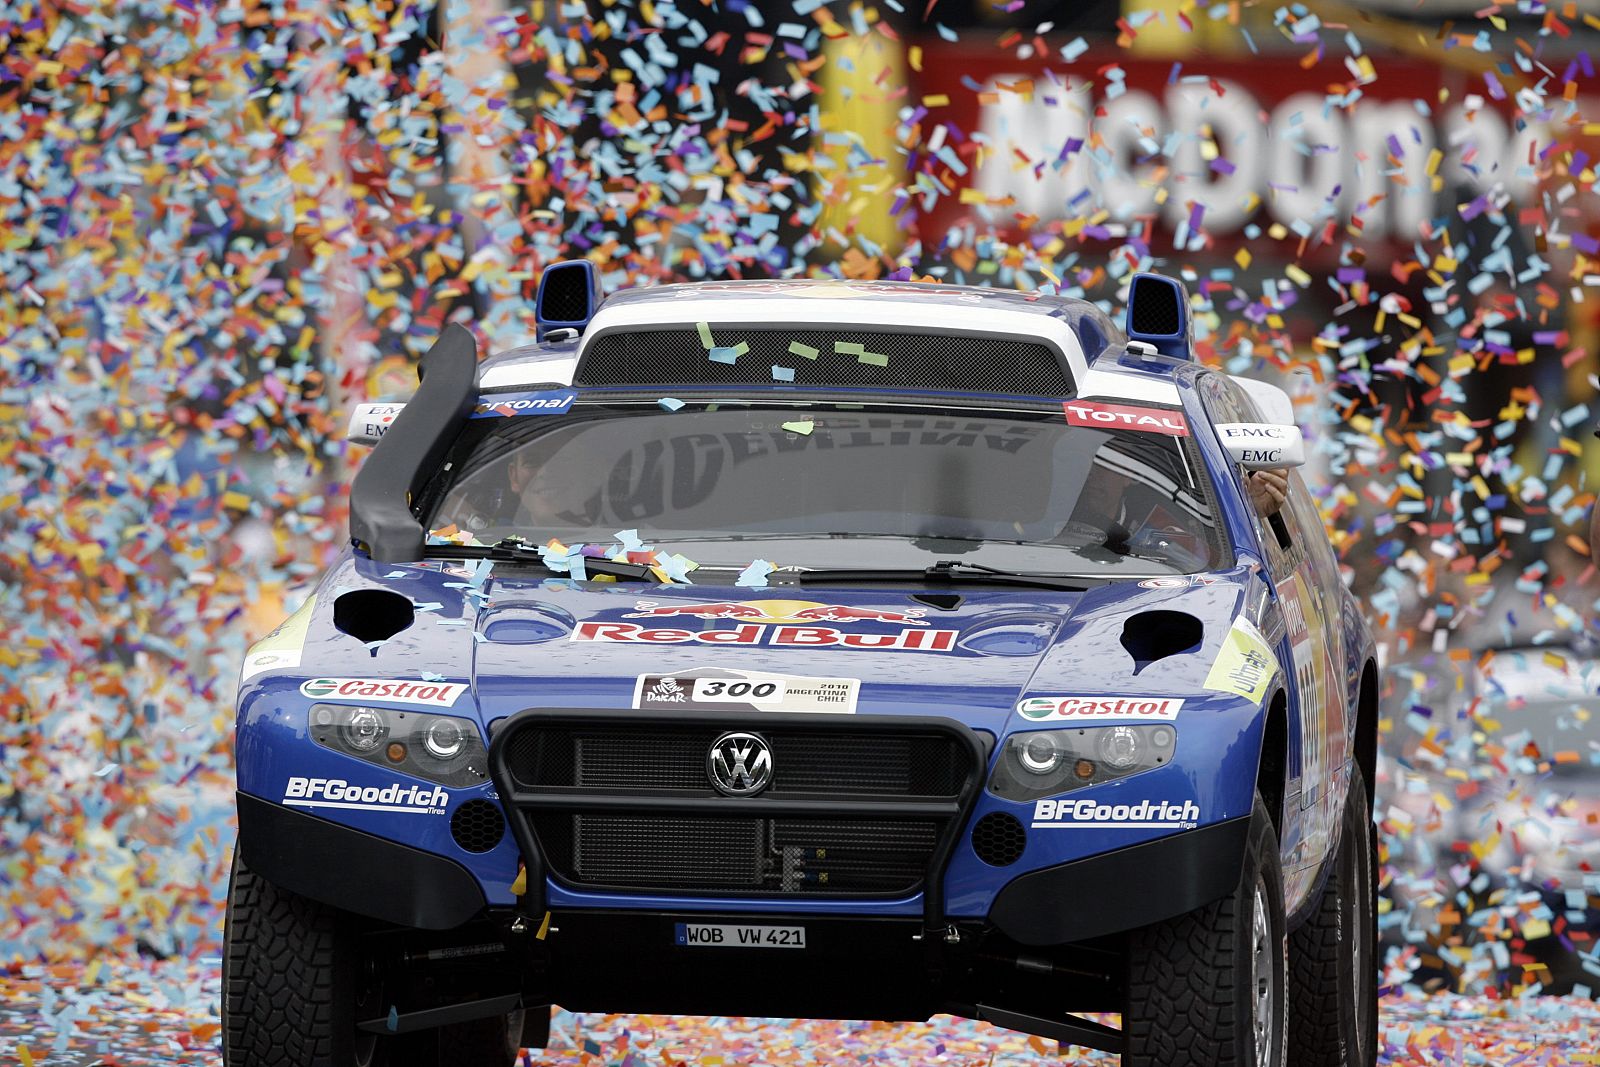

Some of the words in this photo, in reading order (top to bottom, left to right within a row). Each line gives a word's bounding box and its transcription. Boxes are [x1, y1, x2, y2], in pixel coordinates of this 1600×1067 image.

[1068, 406, 1184, 429] TOTAL
[570, 622, 762, 644] Red
[769, 625, 959, 652] Bull
[339, 680, 452, 702] Castrol
[646, 691, 687, 703] DAKAR
[702, 681, 777, 698] 300
[785, 688, 848, 697] ARGENTINA
[816, 695, 847, 703] CHILE
[1058, 699, 1169, 716] Castrol
[285, 776, 449, 806] BFGoodrich
[427, 806, 446, 815] Tires
[1033, 799, 1200, 821] BFGoodrich
[1179, 820, 1198, 830] Tires
[688, 927, 724, 943] WOB
[738, 929, 762, 944] VW
[766, 929, 804, 946] 421
